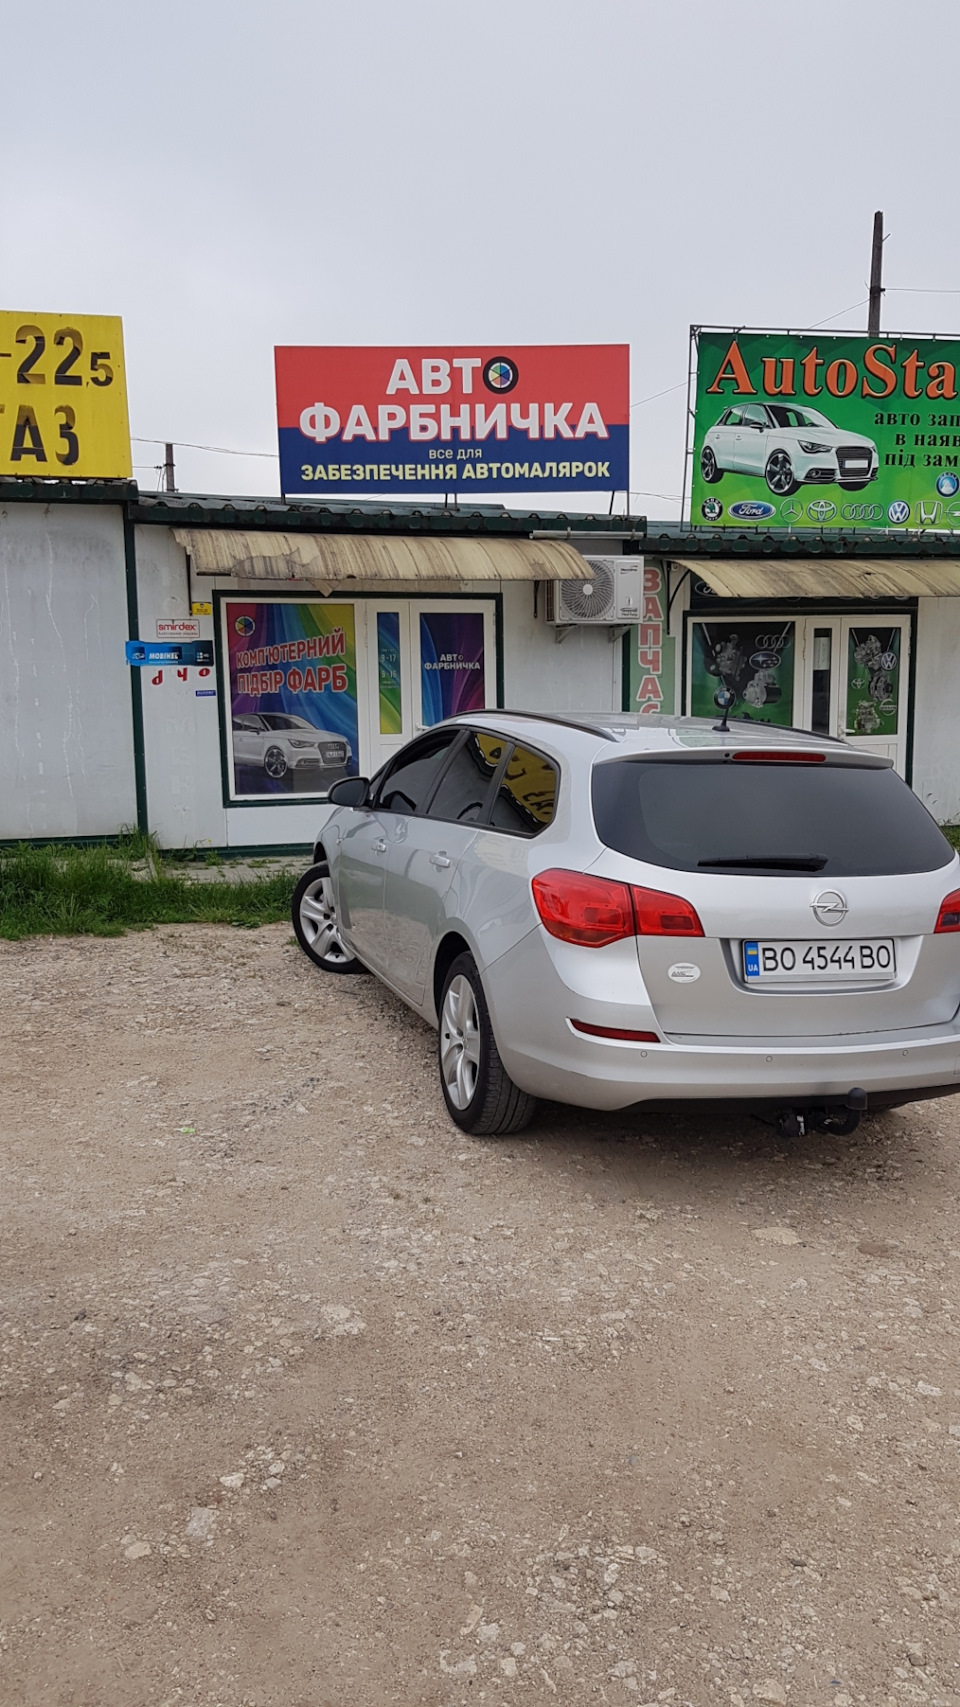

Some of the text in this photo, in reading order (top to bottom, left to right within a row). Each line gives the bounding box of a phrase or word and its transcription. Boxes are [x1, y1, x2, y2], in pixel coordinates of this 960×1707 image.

[706, 339, 958, 400] AutoSta
[299, 402, 610, 442] ФАРБНИЧКА
[874, 412, 921, 426] авто
[0, 403, 80, 466] АЗ
[895, 433, 906, 446] в
[428, 448, 483, 461] все для
[884, 449, 916, 468] під
[300, 461, 611, 481] ЗАБЕЗПЕЧЕННЯ АВТОМАЛЯРОК
[738, 503, 764, 515] Ford
[158, 622, 197, 631] smirdex
[235, 627, 346, 669] КОМП'ЮТЕРНИЙ
[424, 662, 481, 670] ФАРБНИЧКА
[237, 664, 348, 697] ПІДБІР ФАРБ
[762, 944, 891, 972] BO 4544 BO
